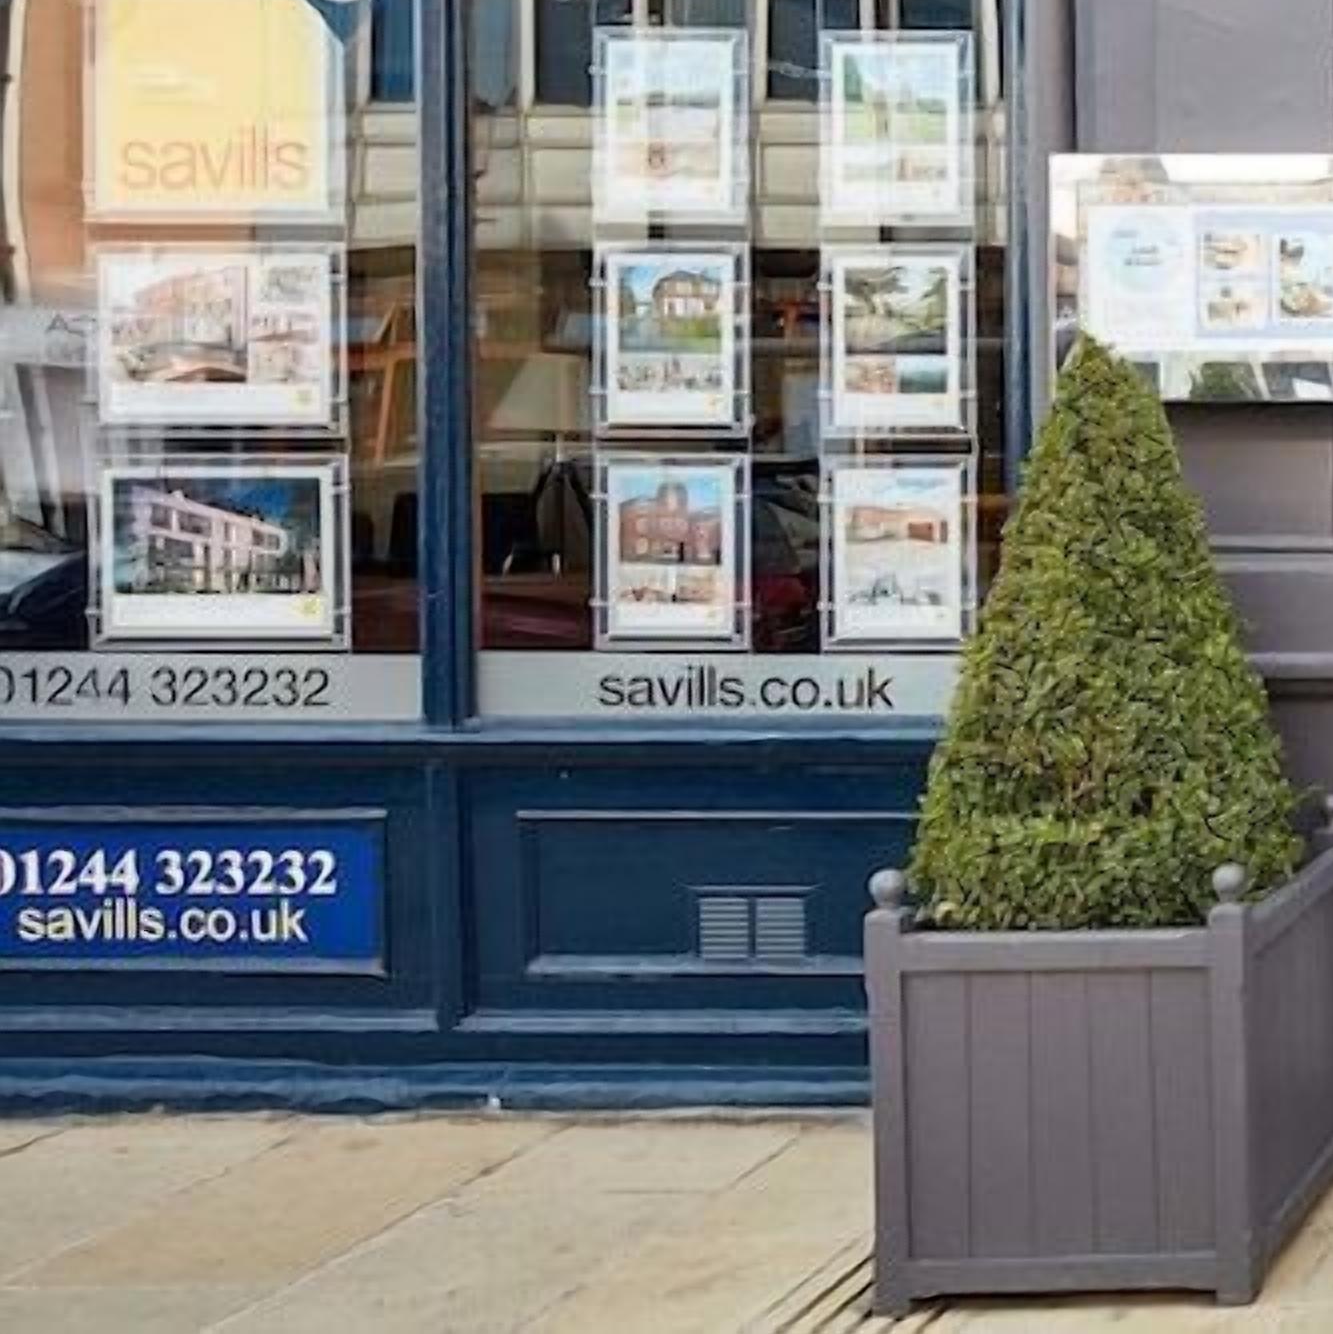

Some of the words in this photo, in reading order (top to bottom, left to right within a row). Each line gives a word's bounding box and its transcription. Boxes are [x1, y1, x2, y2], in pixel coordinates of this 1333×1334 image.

[120, 125, 310, 192] savills
[150, 665, 331, 707] 323232
[599, 664, 894, 710] savills.co.uk
[154, 849, 337, 895] 323232
[18, 897, 308, 942] savills.co.uk
